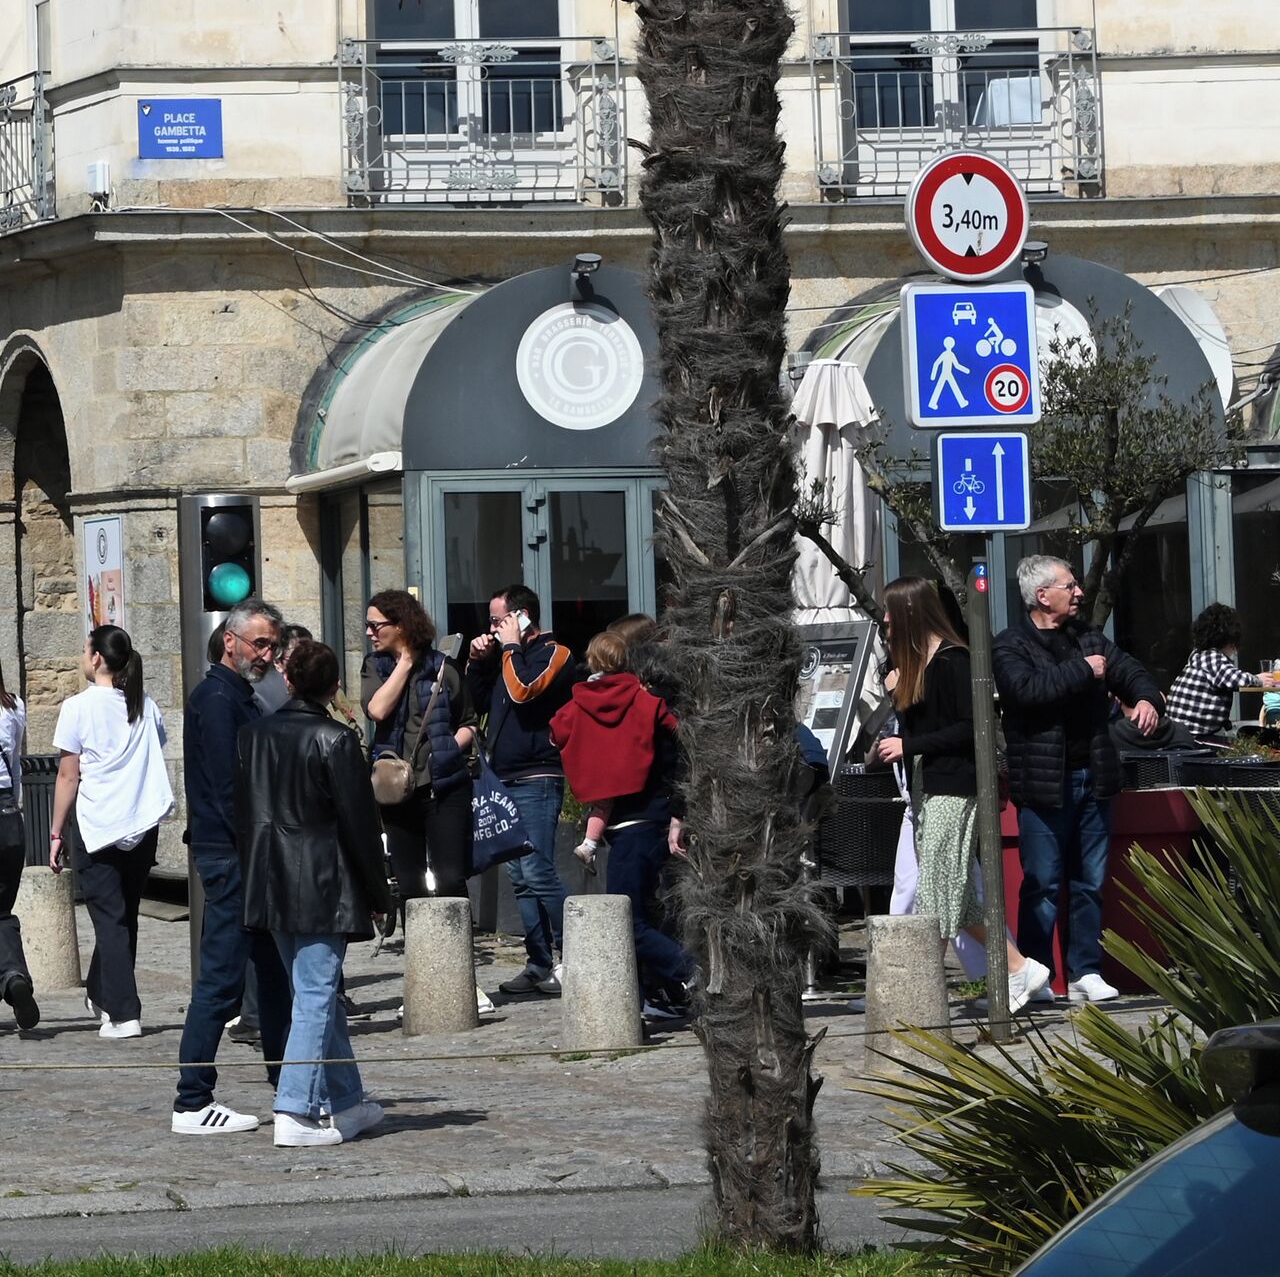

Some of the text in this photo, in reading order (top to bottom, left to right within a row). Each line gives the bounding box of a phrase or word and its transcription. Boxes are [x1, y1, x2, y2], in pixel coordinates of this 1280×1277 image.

[164, 113, 196, 123] PLACE
[154, 126, 207, 136] GAMBETTA
[942, 204, 999, 233] 3,40m
[553, 341, 605, 391] G
[995, 380, 1020, 398] 20
[979, 566, 984, 575] 2
[980, 580, 985, 589] 5
[490, 790, 518, 817] JEANS
[478, 813, 497, 827] 2004
[474, 827, 495, 841] MFG.
[495, 819, 513, 834] CO.
